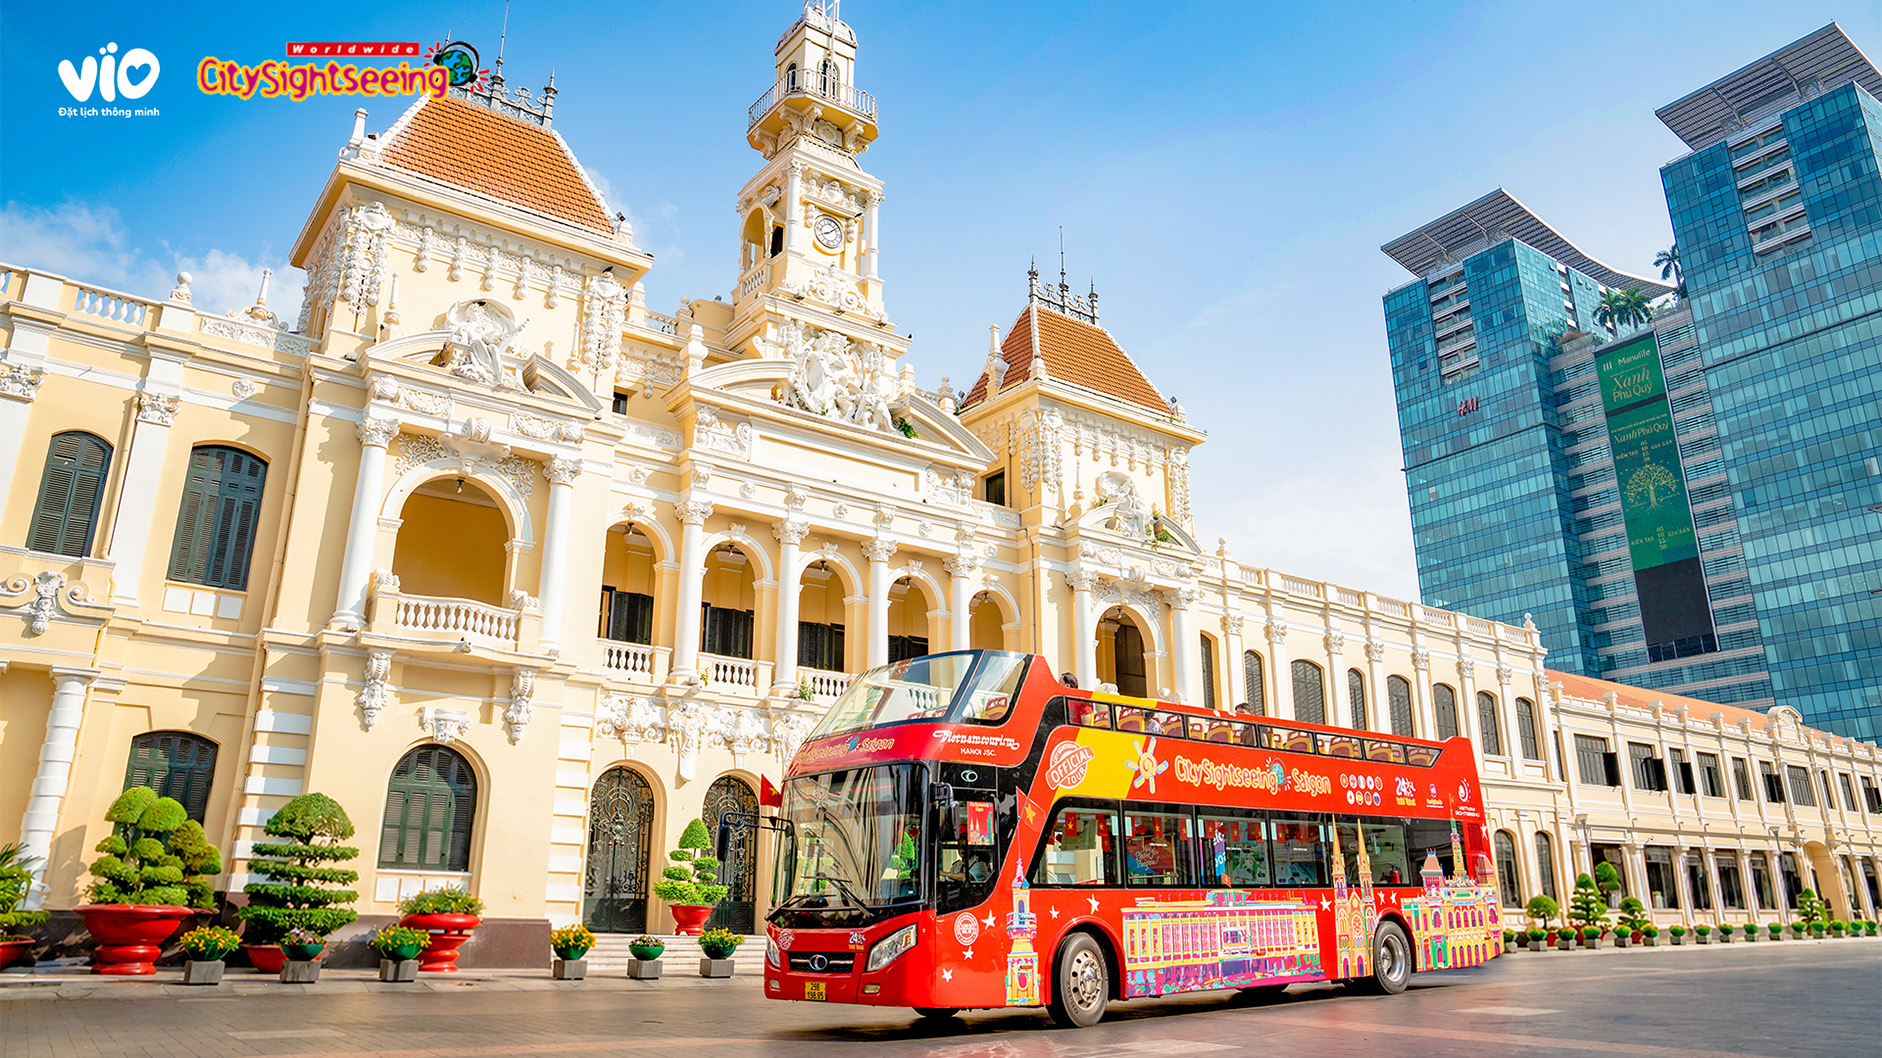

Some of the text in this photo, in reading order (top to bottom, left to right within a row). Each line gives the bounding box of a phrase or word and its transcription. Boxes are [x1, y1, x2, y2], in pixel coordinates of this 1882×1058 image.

[1618, 349, 1651, 366] Manulife
[1613, 367, 1650, 391] Xanh
[860, 738, 895, 753] Saigon
[1051, 748, 1092, 783] OFFICIAL
[1067, 767, 1085, 785] TOUR
[1174, 755, 1331, 797] CitySightseeing Saigon
